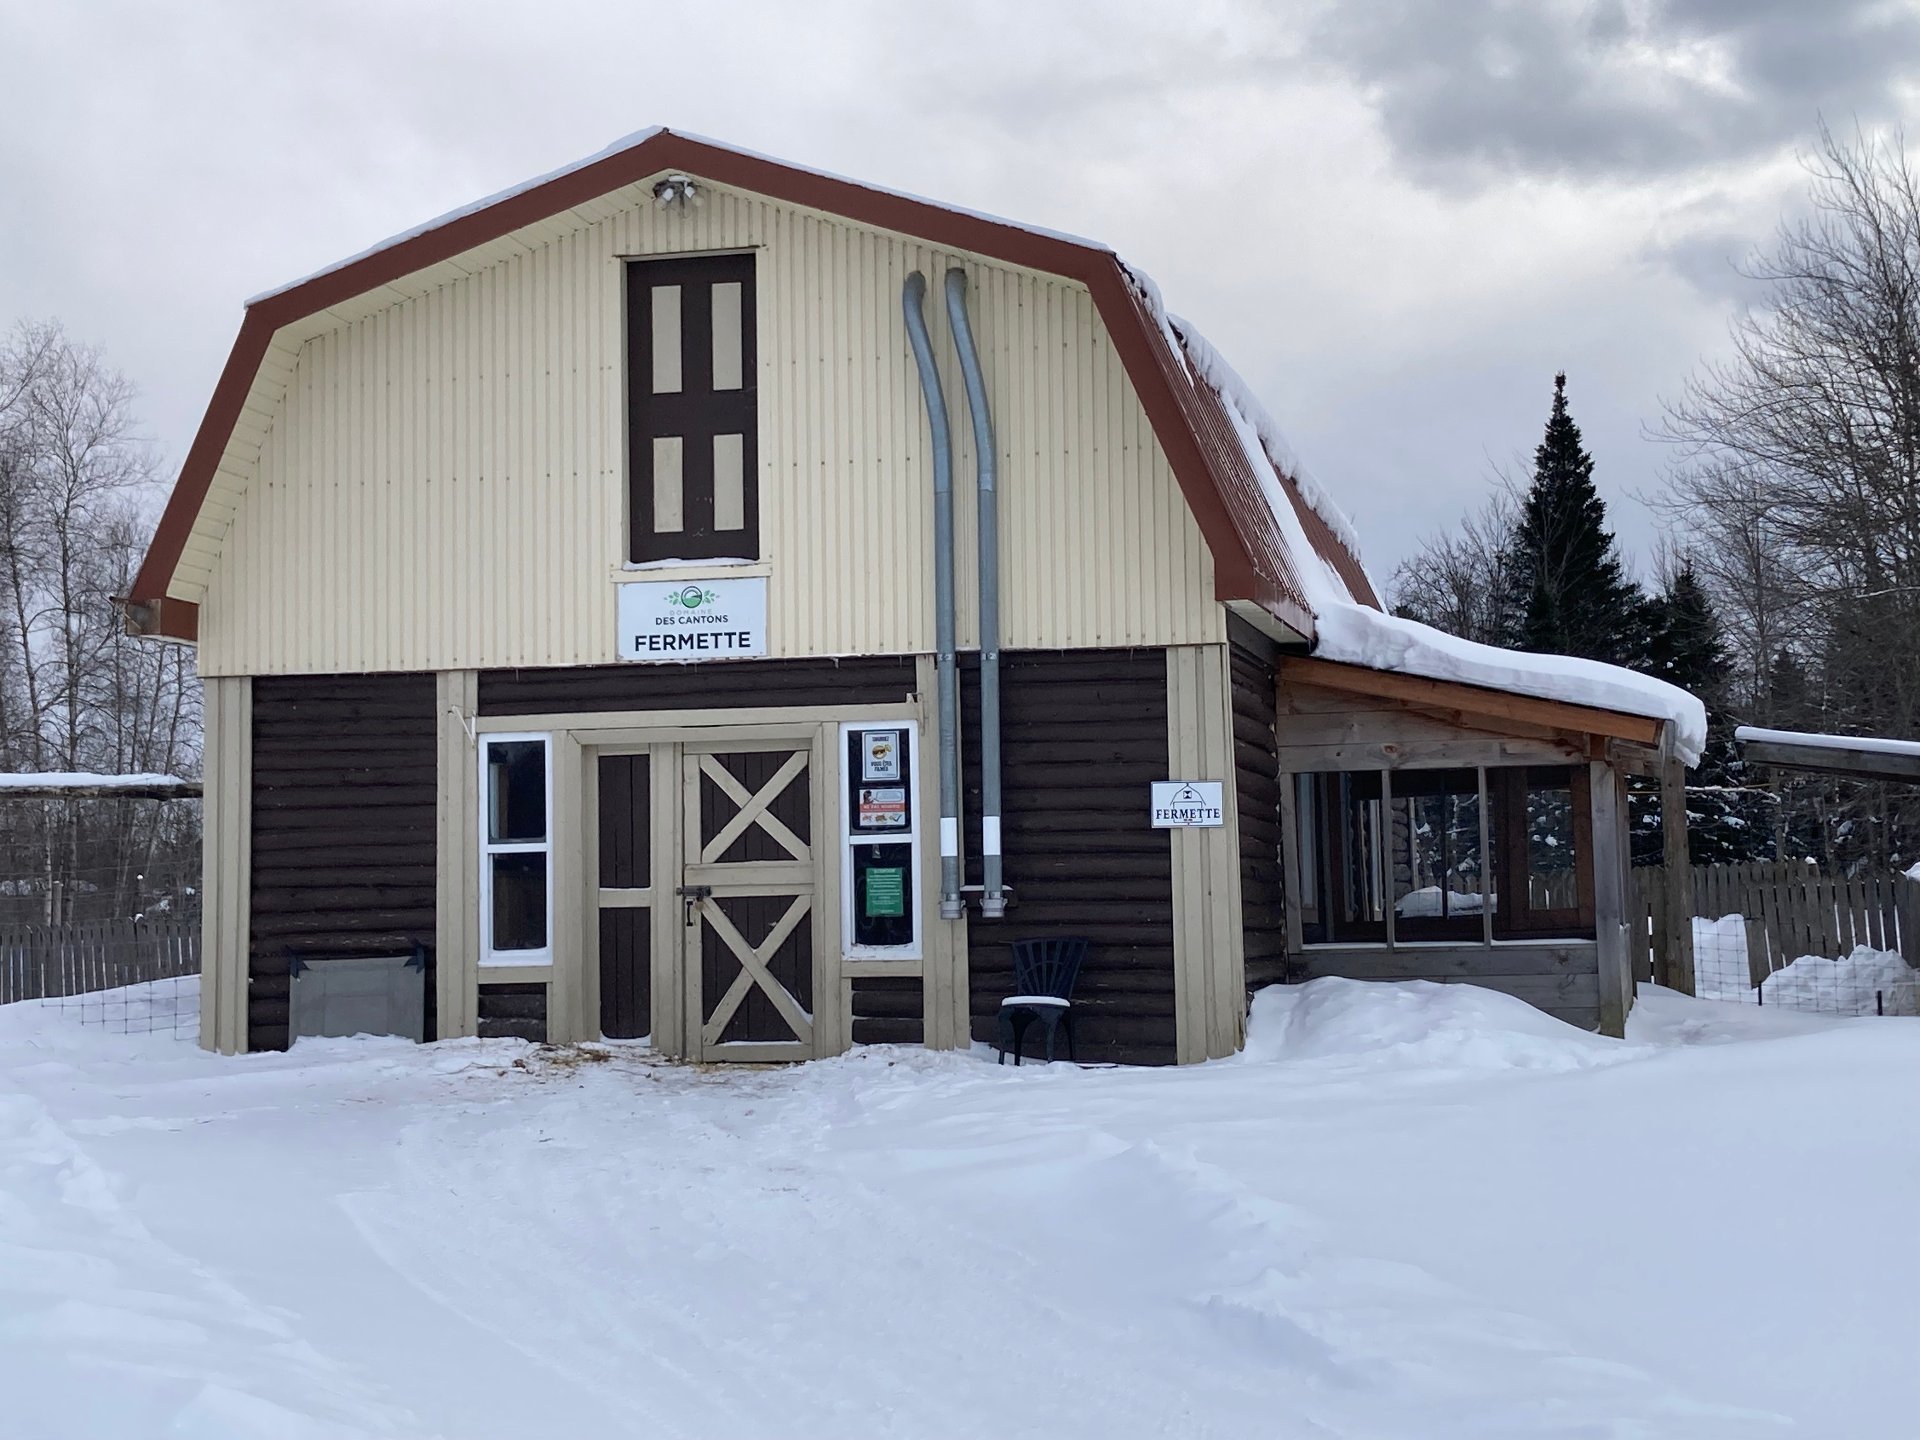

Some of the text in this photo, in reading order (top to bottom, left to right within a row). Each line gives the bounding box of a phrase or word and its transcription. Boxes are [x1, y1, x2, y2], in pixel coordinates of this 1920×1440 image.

[655, 615, 729, 626] DES CANTONS
[635, 632, 751, 651] FERMETTE
[1156, 809, 1220, 819] FERMETTE
